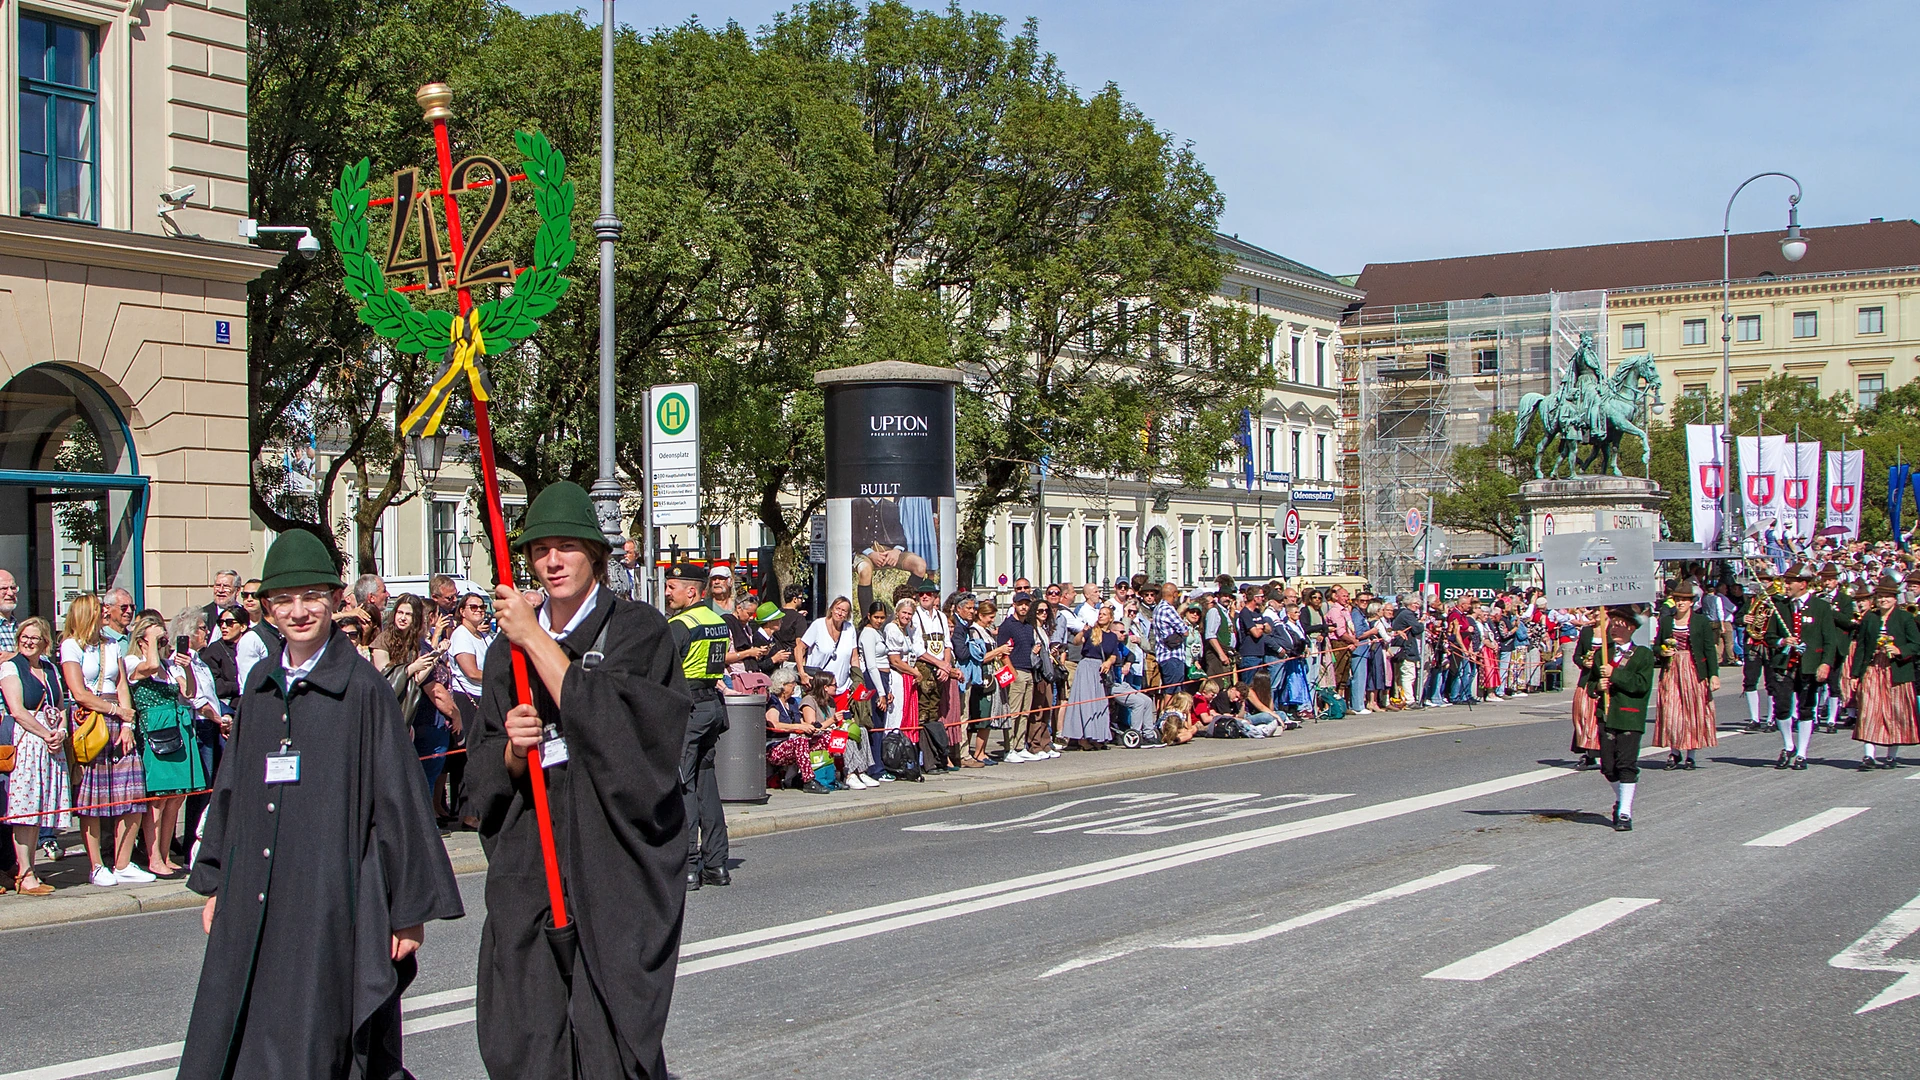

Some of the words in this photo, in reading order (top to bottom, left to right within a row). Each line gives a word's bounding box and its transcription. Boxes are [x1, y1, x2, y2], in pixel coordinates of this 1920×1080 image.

[384, 155, 516, 295] 42
[220, 322, 226, 333] 2
[666, 401, 680, 426] H
[870, 415, 928, 431] UPTON
[658, 451, 689, 459] Odeonsplatz
[1265, 473, 1289, 481] Odeonsplatz
[860, 483, 900, 495] BUILT
[1293, 491, 1332, 501] Odeonsplatz
[1701, 503, 1722, 511] SPATE
[1618, 515, 1643, 529] SPATEN
[704, 625, 729, 637] POLIZEI
